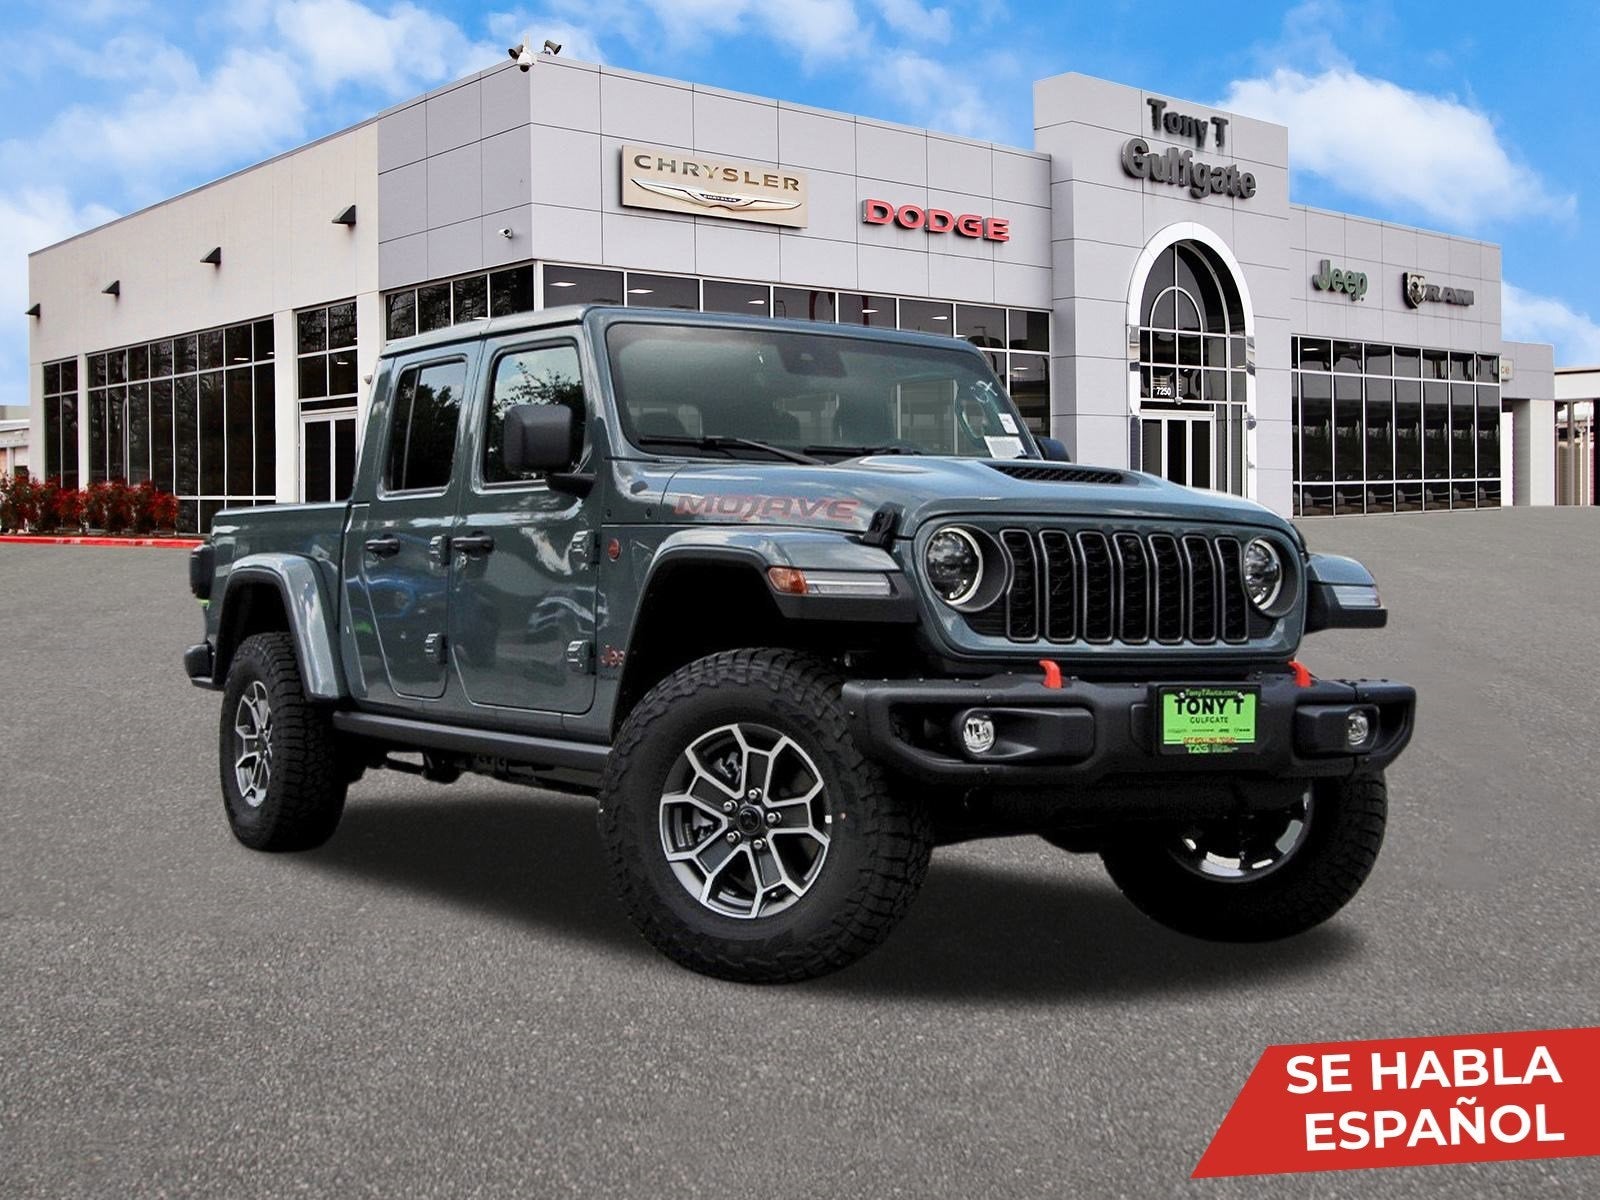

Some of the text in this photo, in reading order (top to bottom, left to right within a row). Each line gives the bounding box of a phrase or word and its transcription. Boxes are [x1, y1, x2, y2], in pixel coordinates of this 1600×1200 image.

[1147, 98, 1229, 147] Tony T
[634, 154, 800, 191] CHRYSLER
[1121, 138, 1256, 198] Gulfgate
[862, 199, 1009, 241] DODGE
[1312, 259, 1368, 301] Jeep
[1425, 284, 1475, 306] RAM
[674, 495, 862, 522] MOJAVE
[1174, 698, 1245, 715] TONY T
